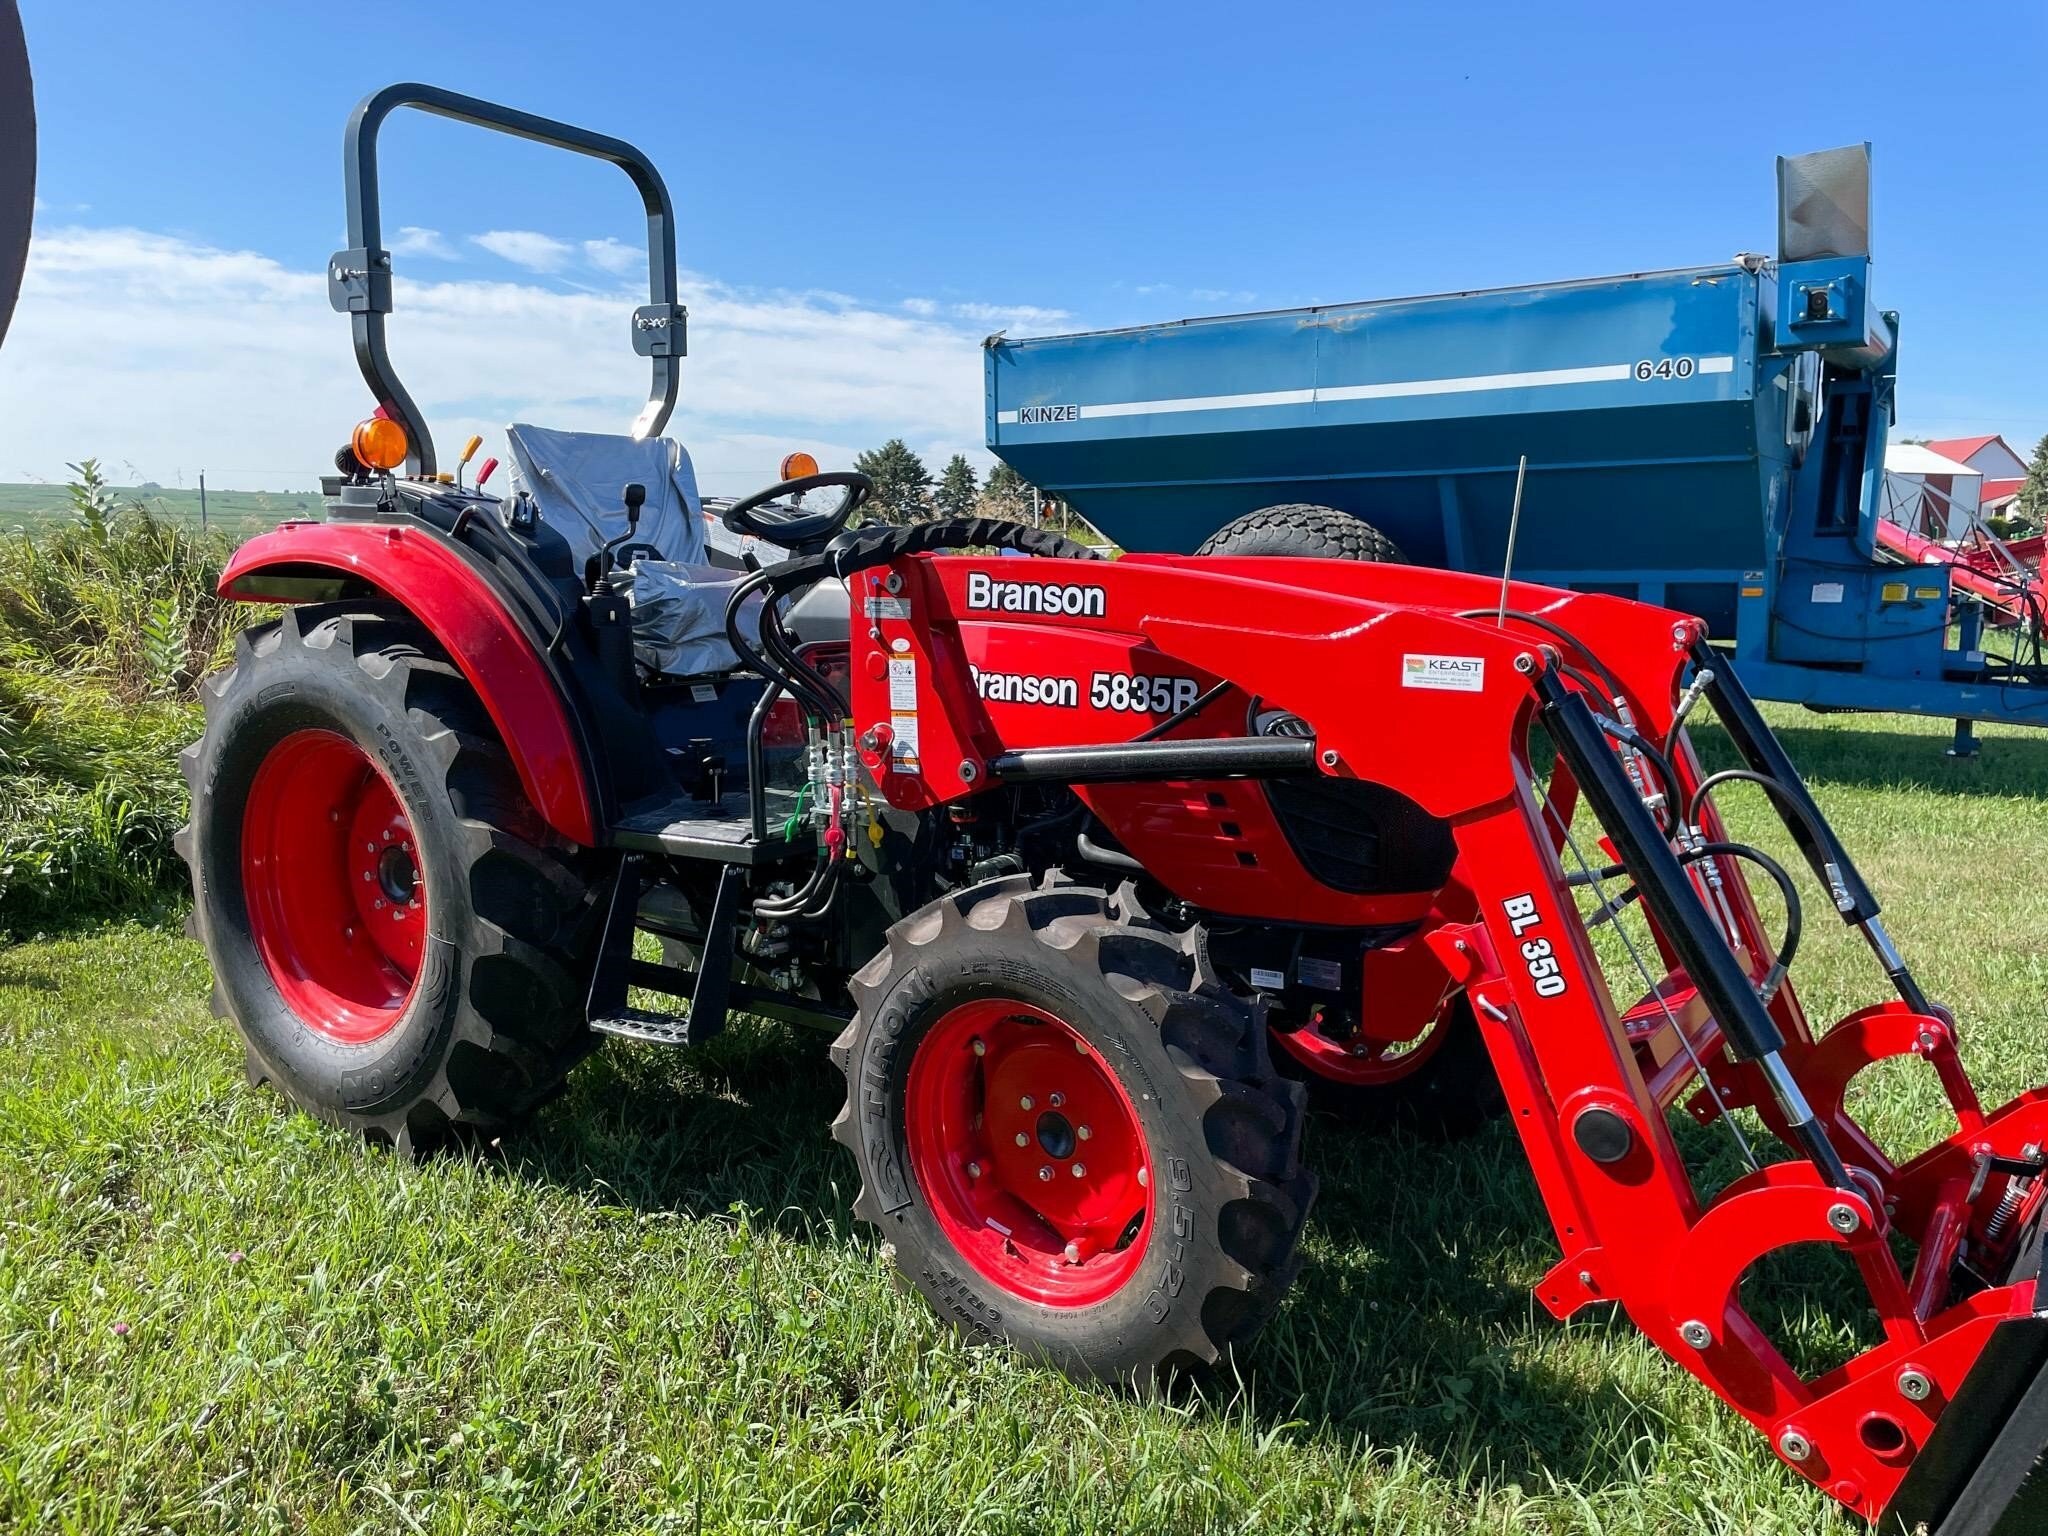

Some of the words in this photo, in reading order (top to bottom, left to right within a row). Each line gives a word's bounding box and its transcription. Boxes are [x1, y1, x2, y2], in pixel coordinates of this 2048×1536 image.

[1636, 358, 1693, 380] 640
[1021, 405, 1077, 424] KINZE
[968, 572, 1106, 617] Branson
[1429, 660, 1482, 671] KEAST
[1090, 672, 1199, 714] 5835R
[376, 722, 433, 821] POWER
[1503, 894, 1541, 936] BL
[1521, 938, 1566, 997] 350
[863, 978, 925, 1124] TIRON
[1143, 1156, 1194, 1325] 9.5-20
[940, 1269, 1002, 1324] GRIP
